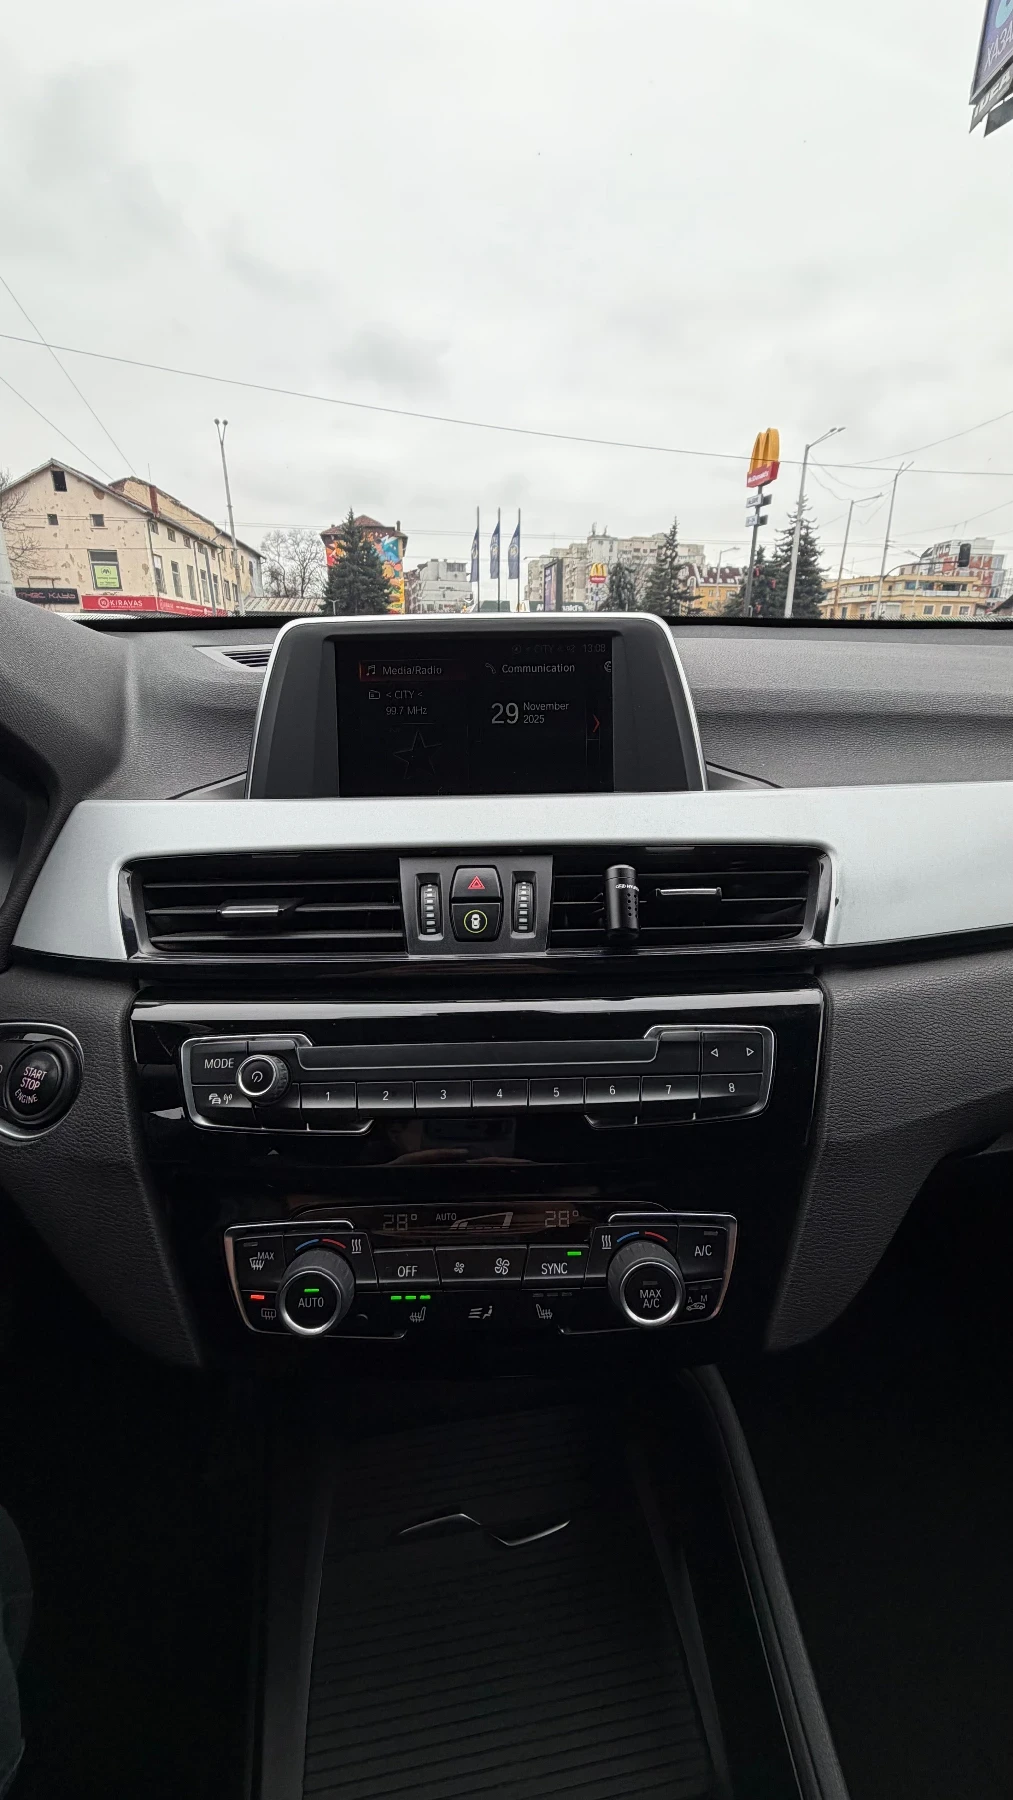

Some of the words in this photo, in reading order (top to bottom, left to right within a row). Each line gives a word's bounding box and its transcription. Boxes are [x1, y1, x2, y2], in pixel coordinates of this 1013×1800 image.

[382, 665, 442, 675] Media/Radio
[501, 663, 576, 673] Communication
[394, 690, 415, 699] CITY
[385, 706, 404, 716] 99.7
[407, 706, 428, 715] MHz
[523, 701, 569, 711] November
[491, 702, 519, 724] 29
[523, 714, 545, 724] 2025
[204, 1057, 235, 1069] MODE
[23, 1066, 47, 1081] START
[20, 1077, 41, 1091] STOP
[665, 1084, 672, 1095] 7
[728, 1082, 736, 1093] 8
[14, 1088, 38, 1104] ENGINE
[382, 1090, 390, 1101] 2
[440, 1089, 448, 1100] 3
[496, 1088, 503, 1099] 4
[553, 1087, 560, 1098] 5
[609, 1085, 616, 1096] 6
[324, 1091, 331, 1102] 1
[435, 1212, 457, 1222] AUTO
[257, 1251, 275, 1261] MAX
[694, 1244, 712, 1257] A/C
[397, 1265, 418, 1278] OFF
[541, 1262, 568, 1275] SYNC
[639, 1288, 662, 1299] MAX
[298, 1296, 324, 1308] AUTO
[642, 1298, 660, 1309] A/C
